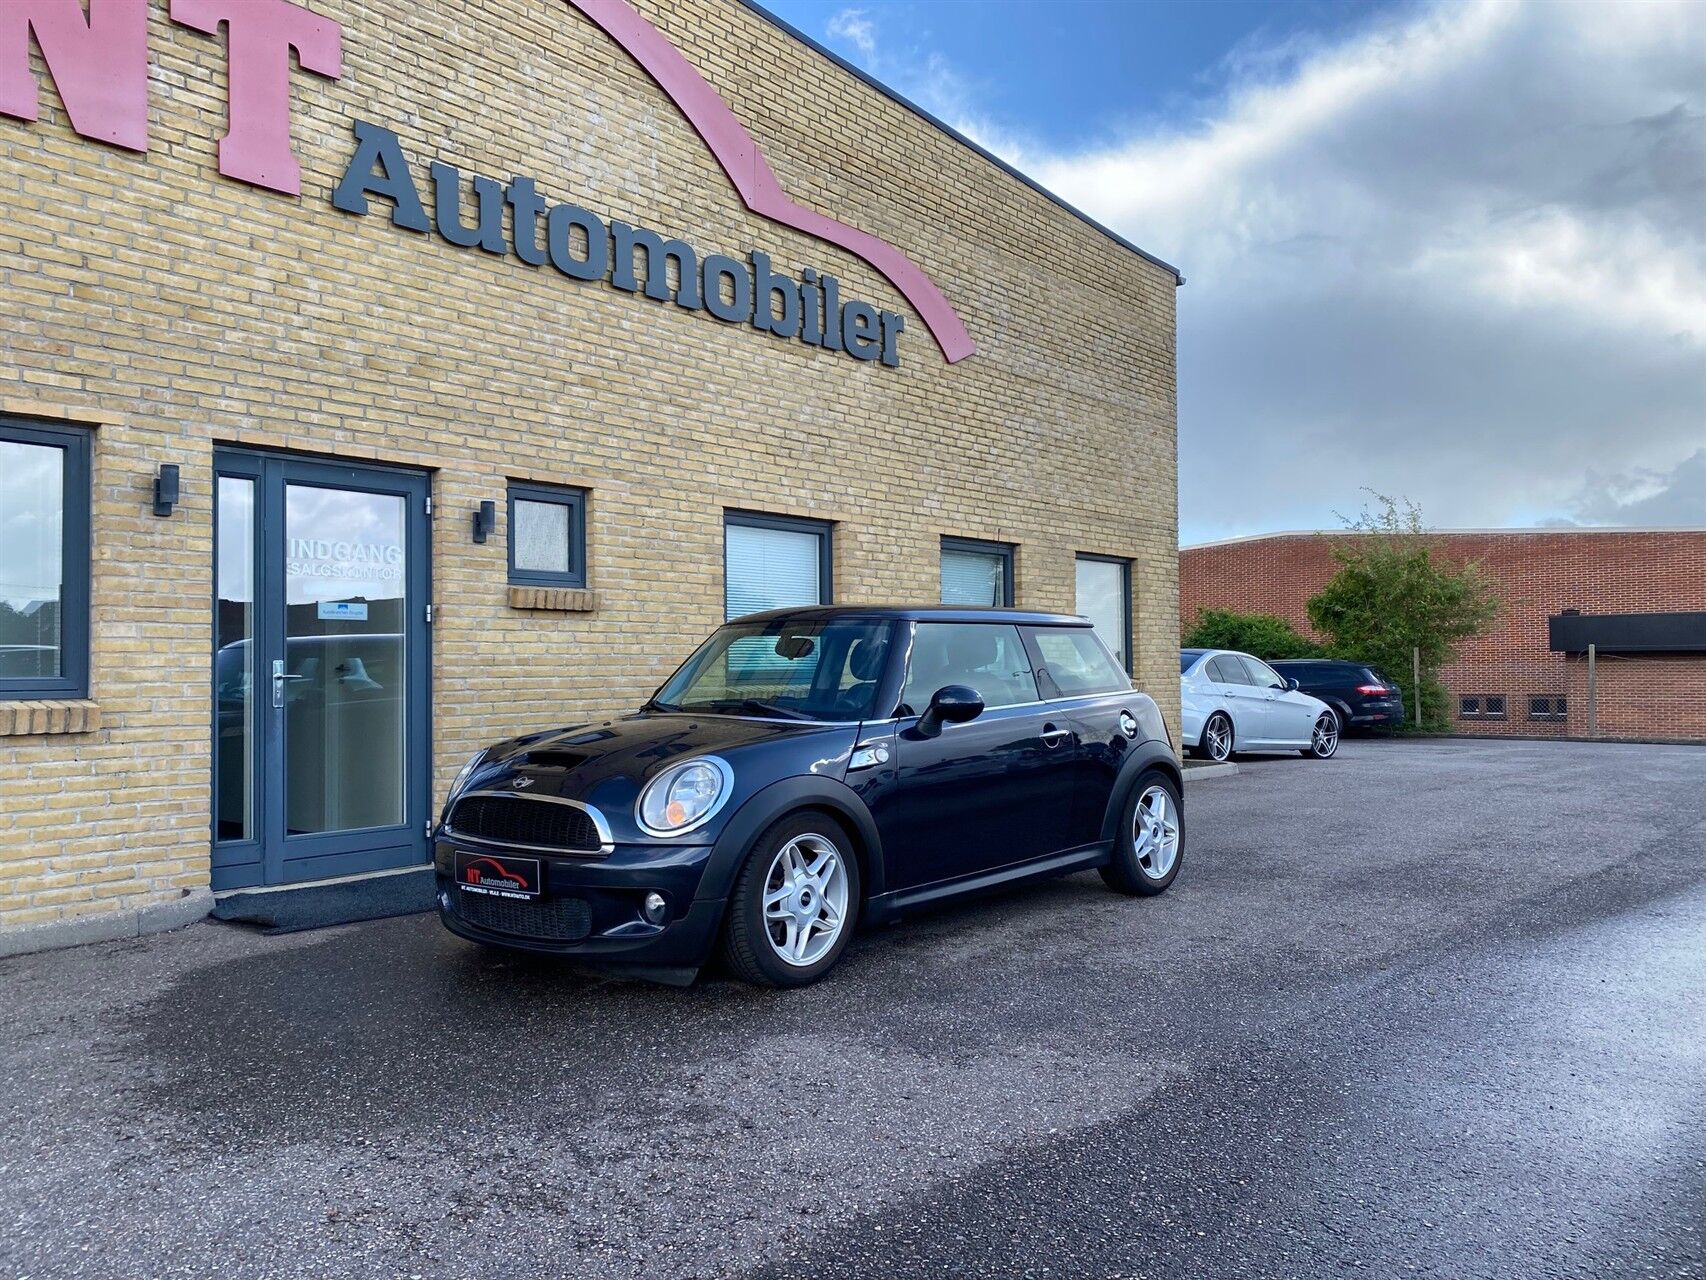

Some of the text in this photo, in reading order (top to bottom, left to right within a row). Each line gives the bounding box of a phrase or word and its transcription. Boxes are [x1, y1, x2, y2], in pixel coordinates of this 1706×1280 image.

[0, 0, 904, 367] NT Automobiler
[290, 538, 401, 565] INDGANG
[480, 876, 520, 890] Automobiler
